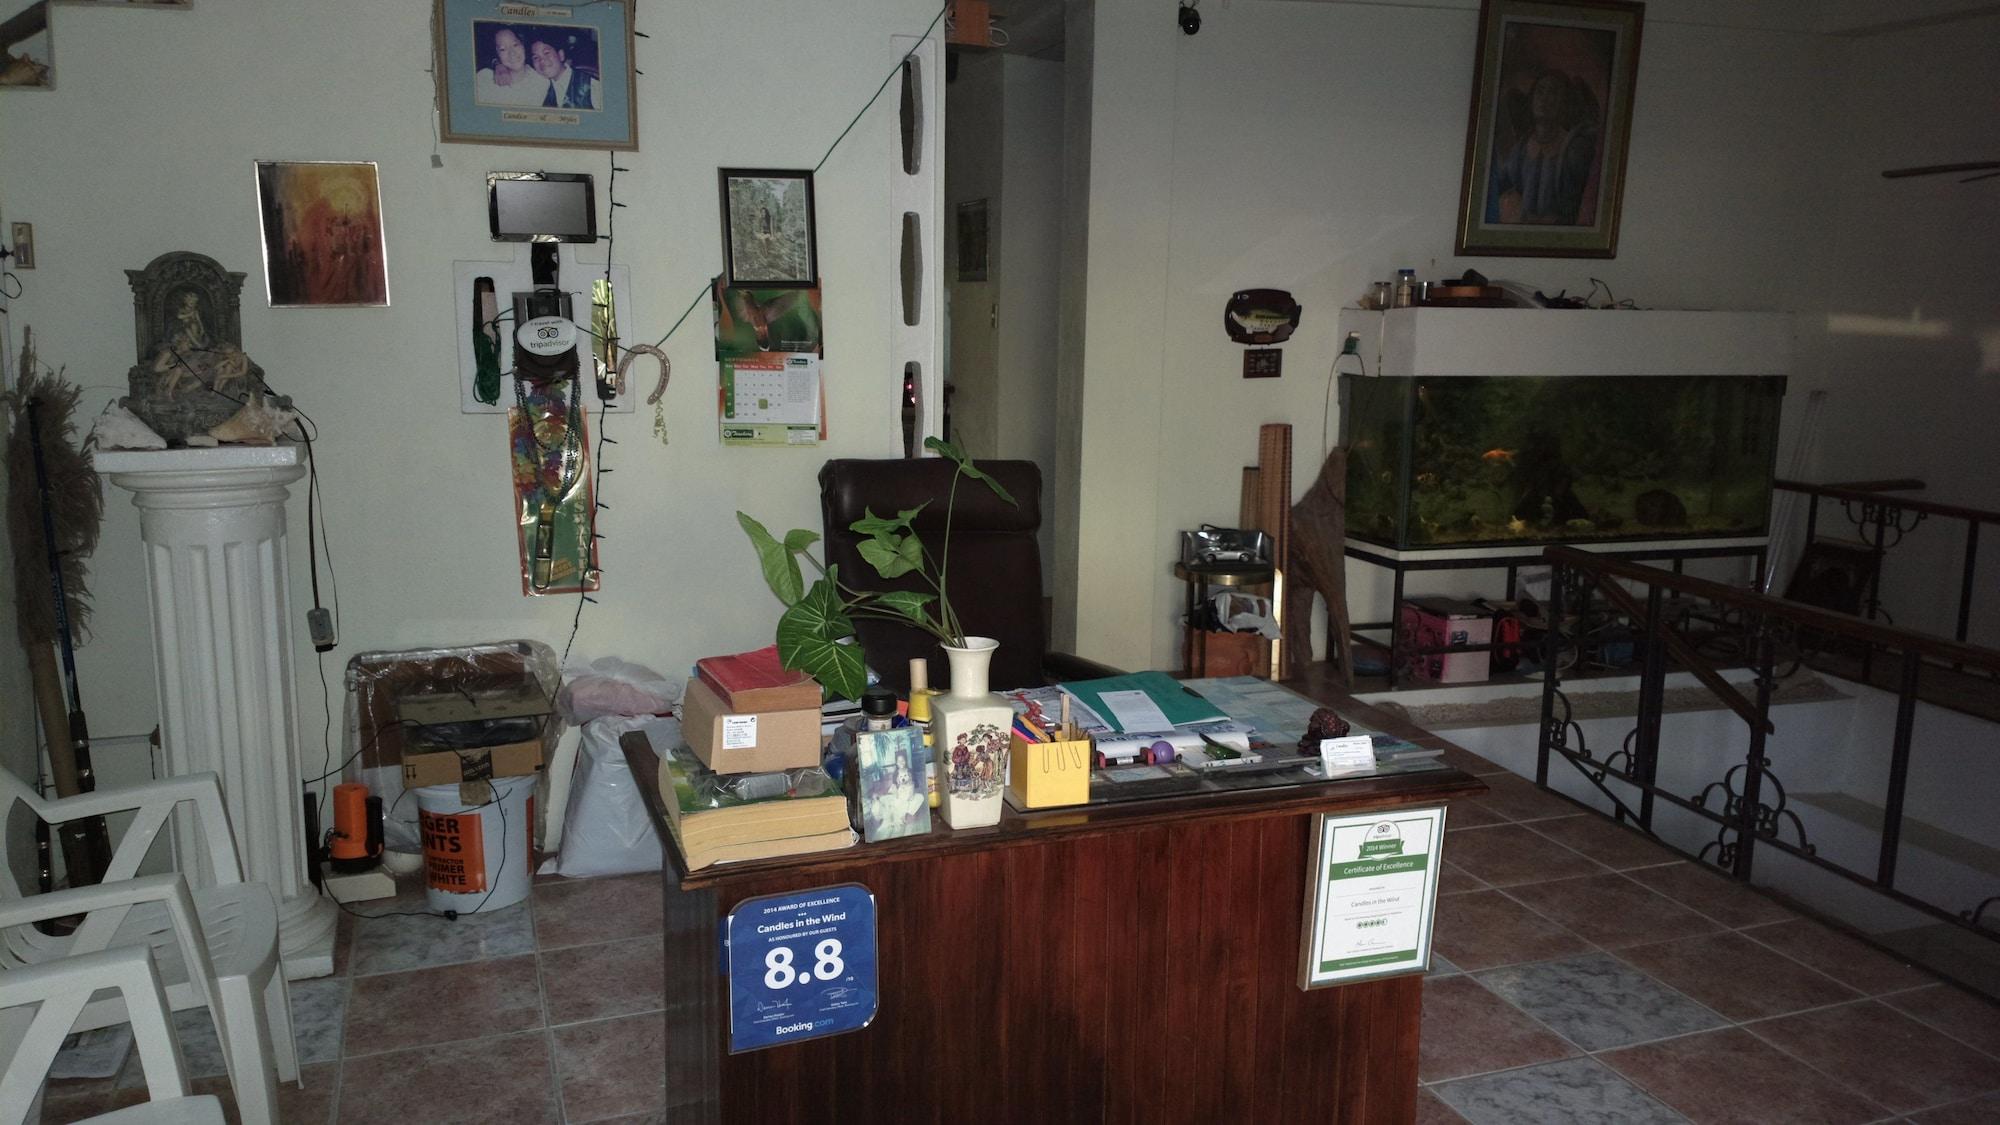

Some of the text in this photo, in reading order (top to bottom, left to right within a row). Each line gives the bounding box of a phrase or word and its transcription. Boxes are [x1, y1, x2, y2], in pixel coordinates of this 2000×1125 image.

[501, 6, 535, 16] Candles
[530, 340, 569, 349] tripadvisor
[1379, 843, 1397, 851] Winner
[1343, 861, 1414, 875] Certificate of Excellence
[778, 903, 798, 912] AWARD
[807, 897, 840, 907] EXCELLENCE
[757, 912, 846, 934] Candles in the Wind
[820, 926, 837, 934] GUESTS
[764, 938, 845, 990] 8.8
[776, 1018, 834, 1036] Booking.com
